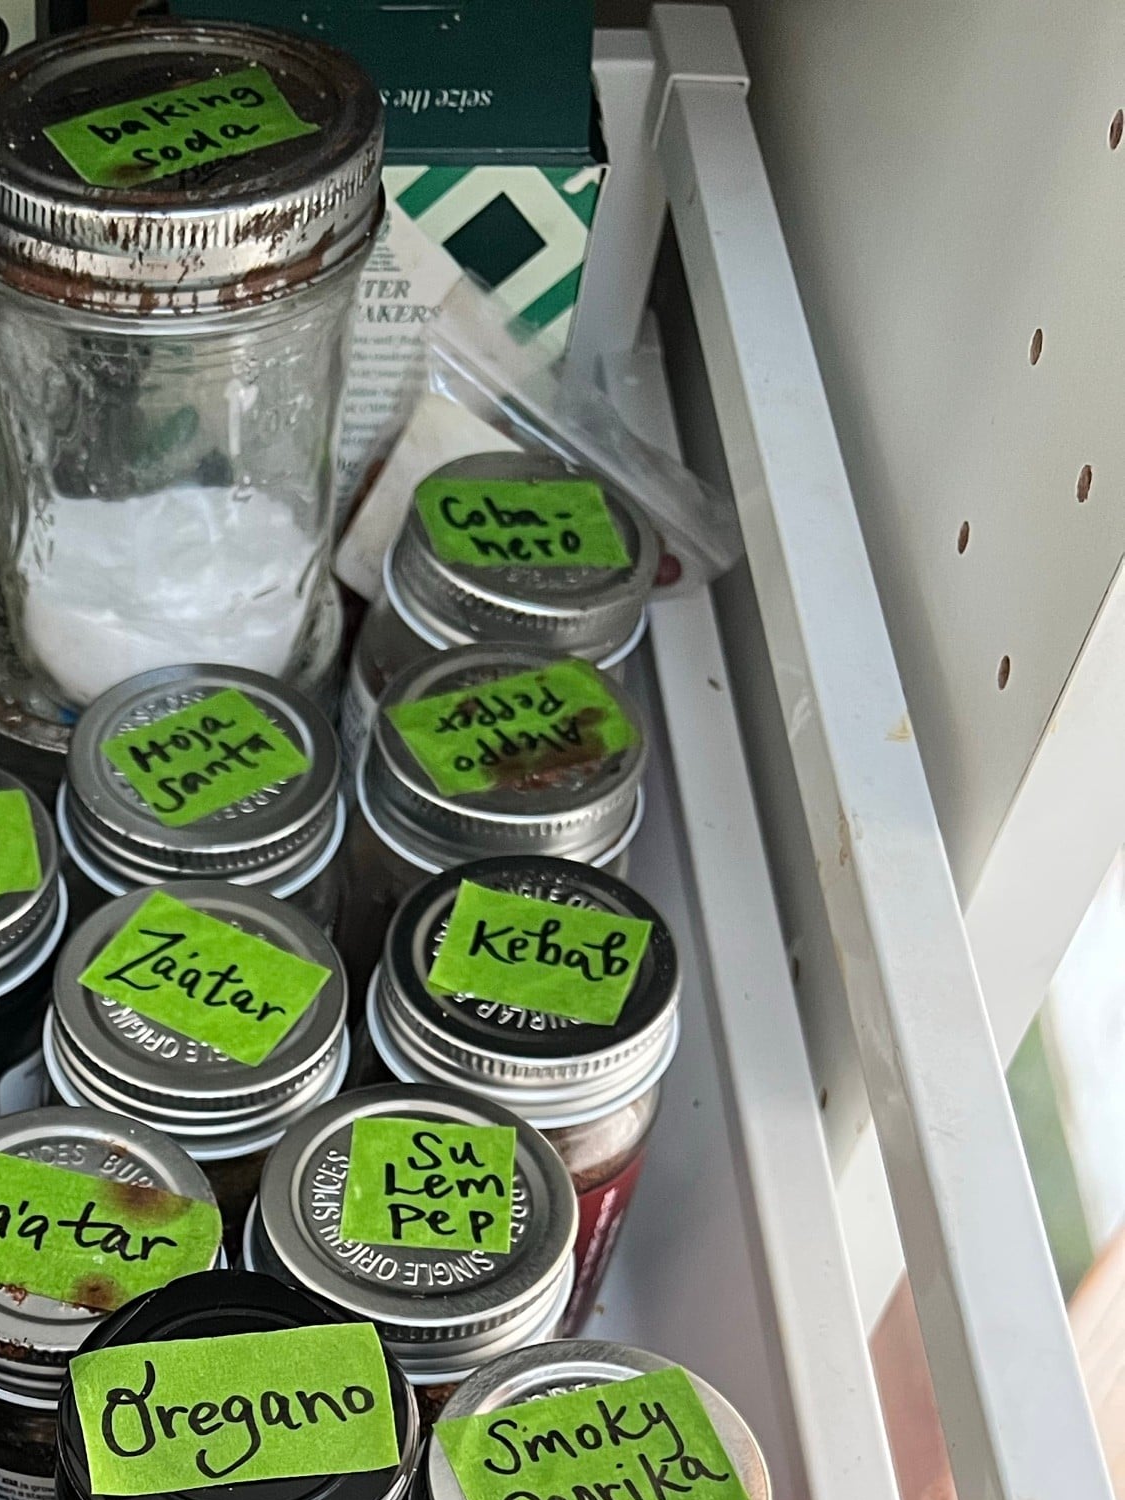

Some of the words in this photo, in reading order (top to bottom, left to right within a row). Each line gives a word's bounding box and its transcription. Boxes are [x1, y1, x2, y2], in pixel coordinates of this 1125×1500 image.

[87, 86, 265, 145] baking
[434, 88, 493, 113] seize
[133, 123, 261, 167] soda
[128, 715, 237, 773] Hoja
[153, 732, 276, 813] Santa
[468, 918, 630, 982] Kebab
[407, 1131, 486, 1171] Su
[384, 1162, 506, 1200] Lem
[101, 1360, 376, 1479] Oregano
[483, 1400, 684, 1476] Smoky
